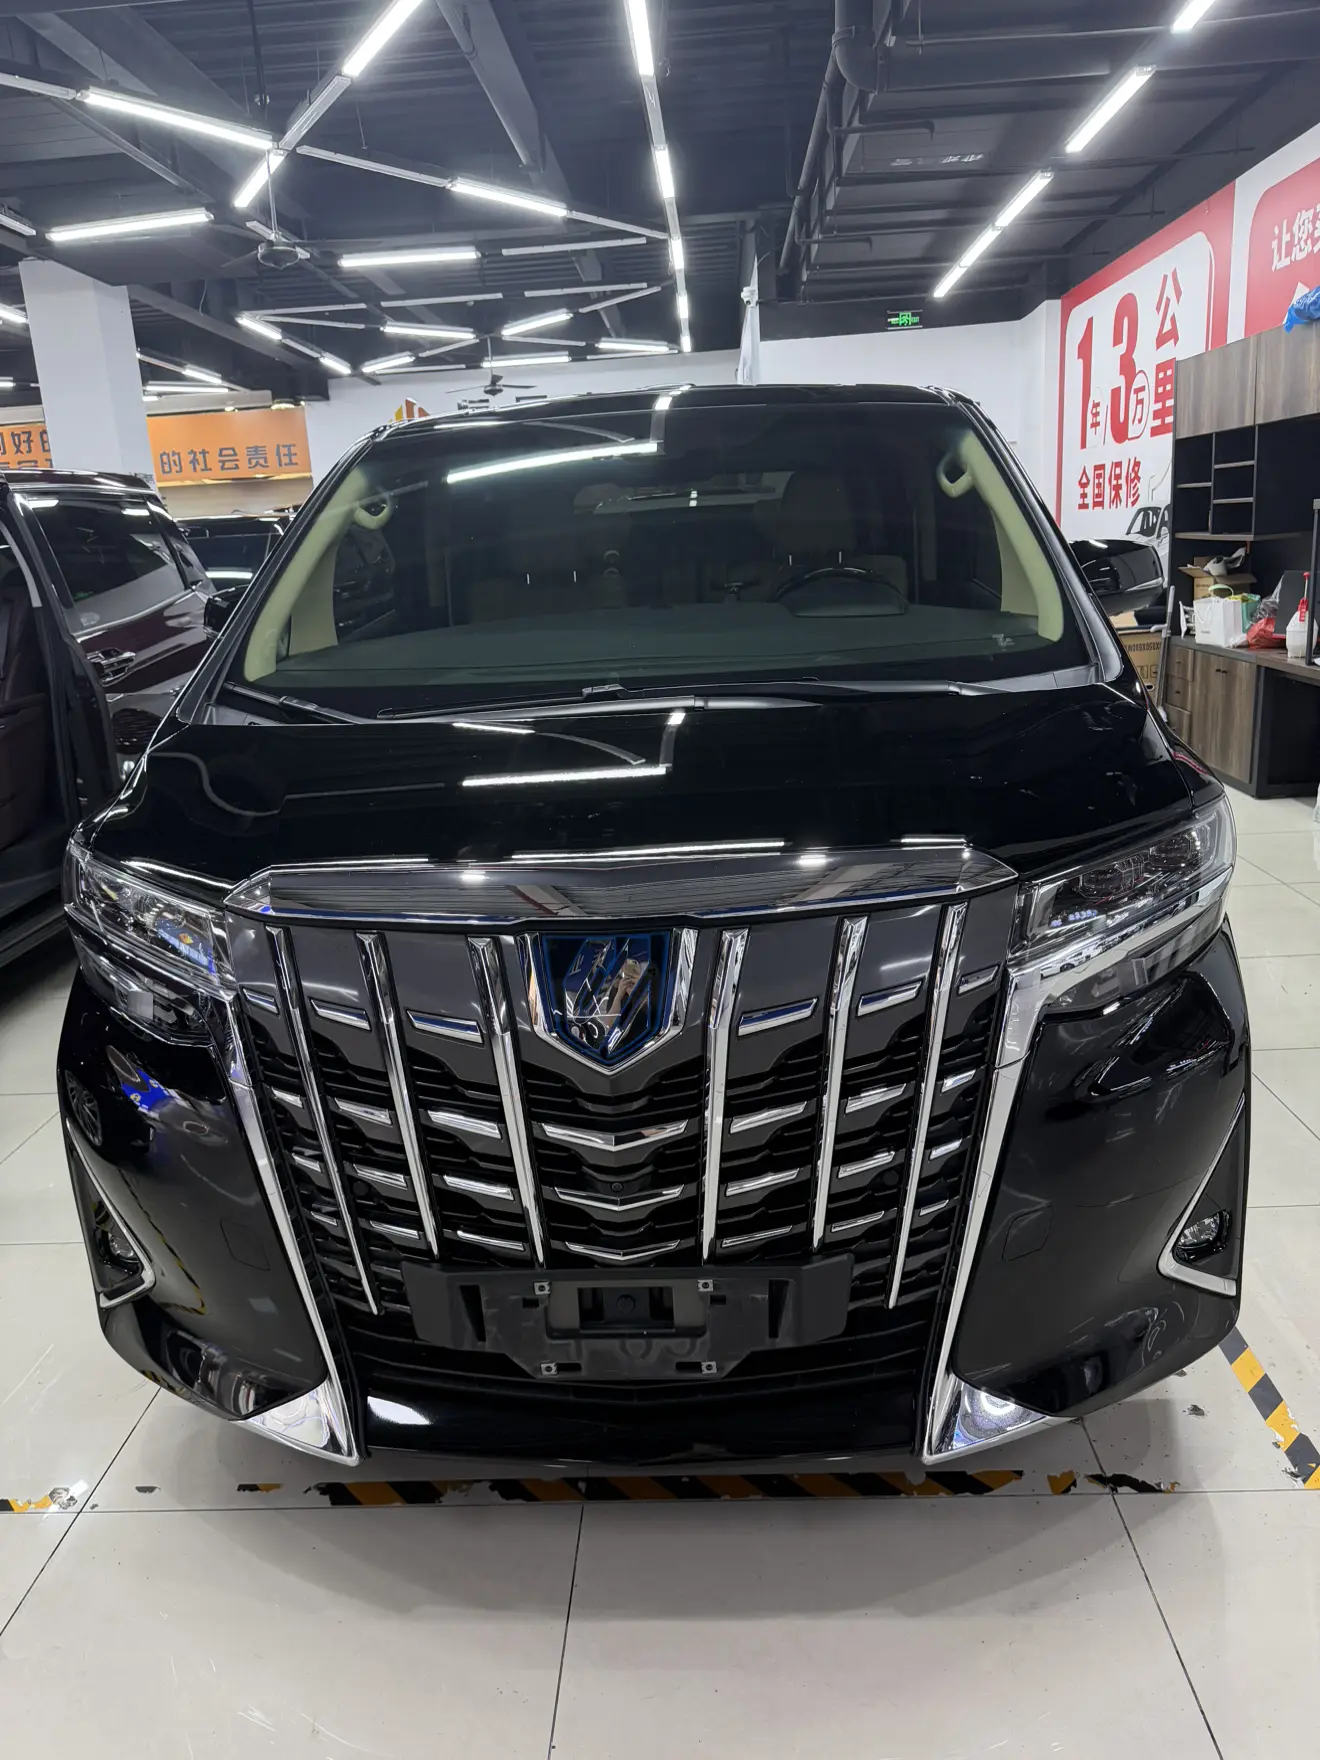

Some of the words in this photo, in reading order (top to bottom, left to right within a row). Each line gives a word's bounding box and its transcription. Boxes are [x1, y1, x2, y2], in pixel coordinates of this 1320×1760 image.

[159, 443, 299, 475] 的社会责任
[1078, 456, 1142, 510] 全国保修
